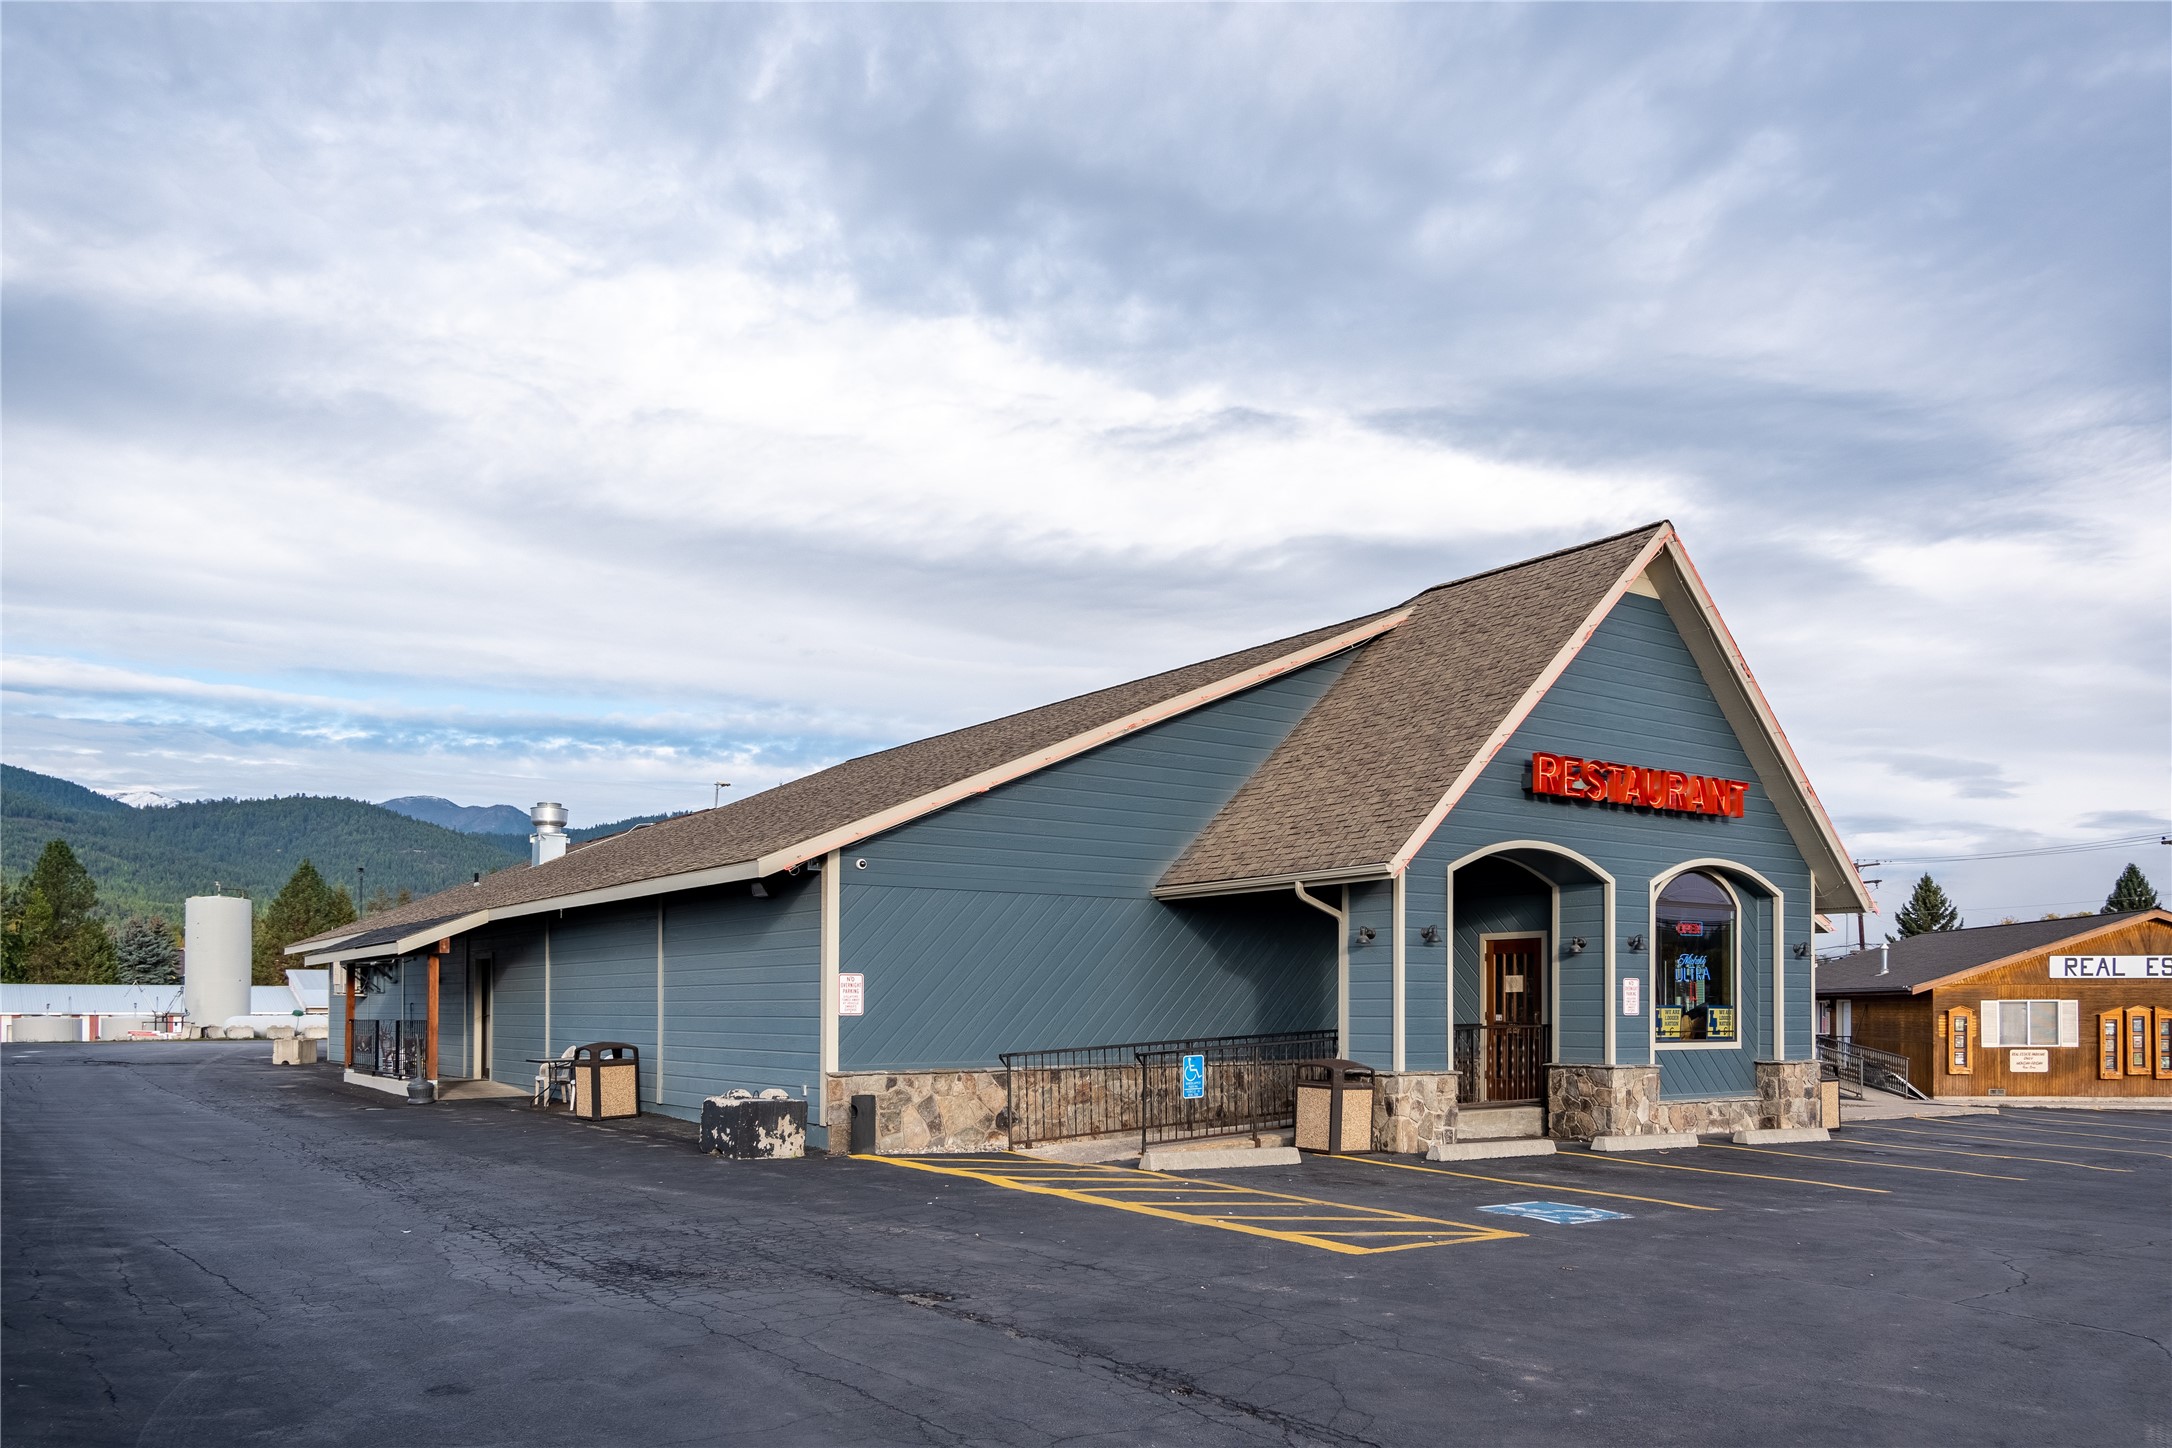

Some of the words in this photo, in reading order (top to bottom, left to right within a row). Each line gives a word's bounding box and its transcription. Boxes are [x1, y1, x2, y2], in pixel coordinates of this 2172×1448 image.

[1532, 752, 1749, 818] RESTAURANT
[1675, 966, 1711, 983] ULTRA
[2064, 957, 2126, 977] REAL
